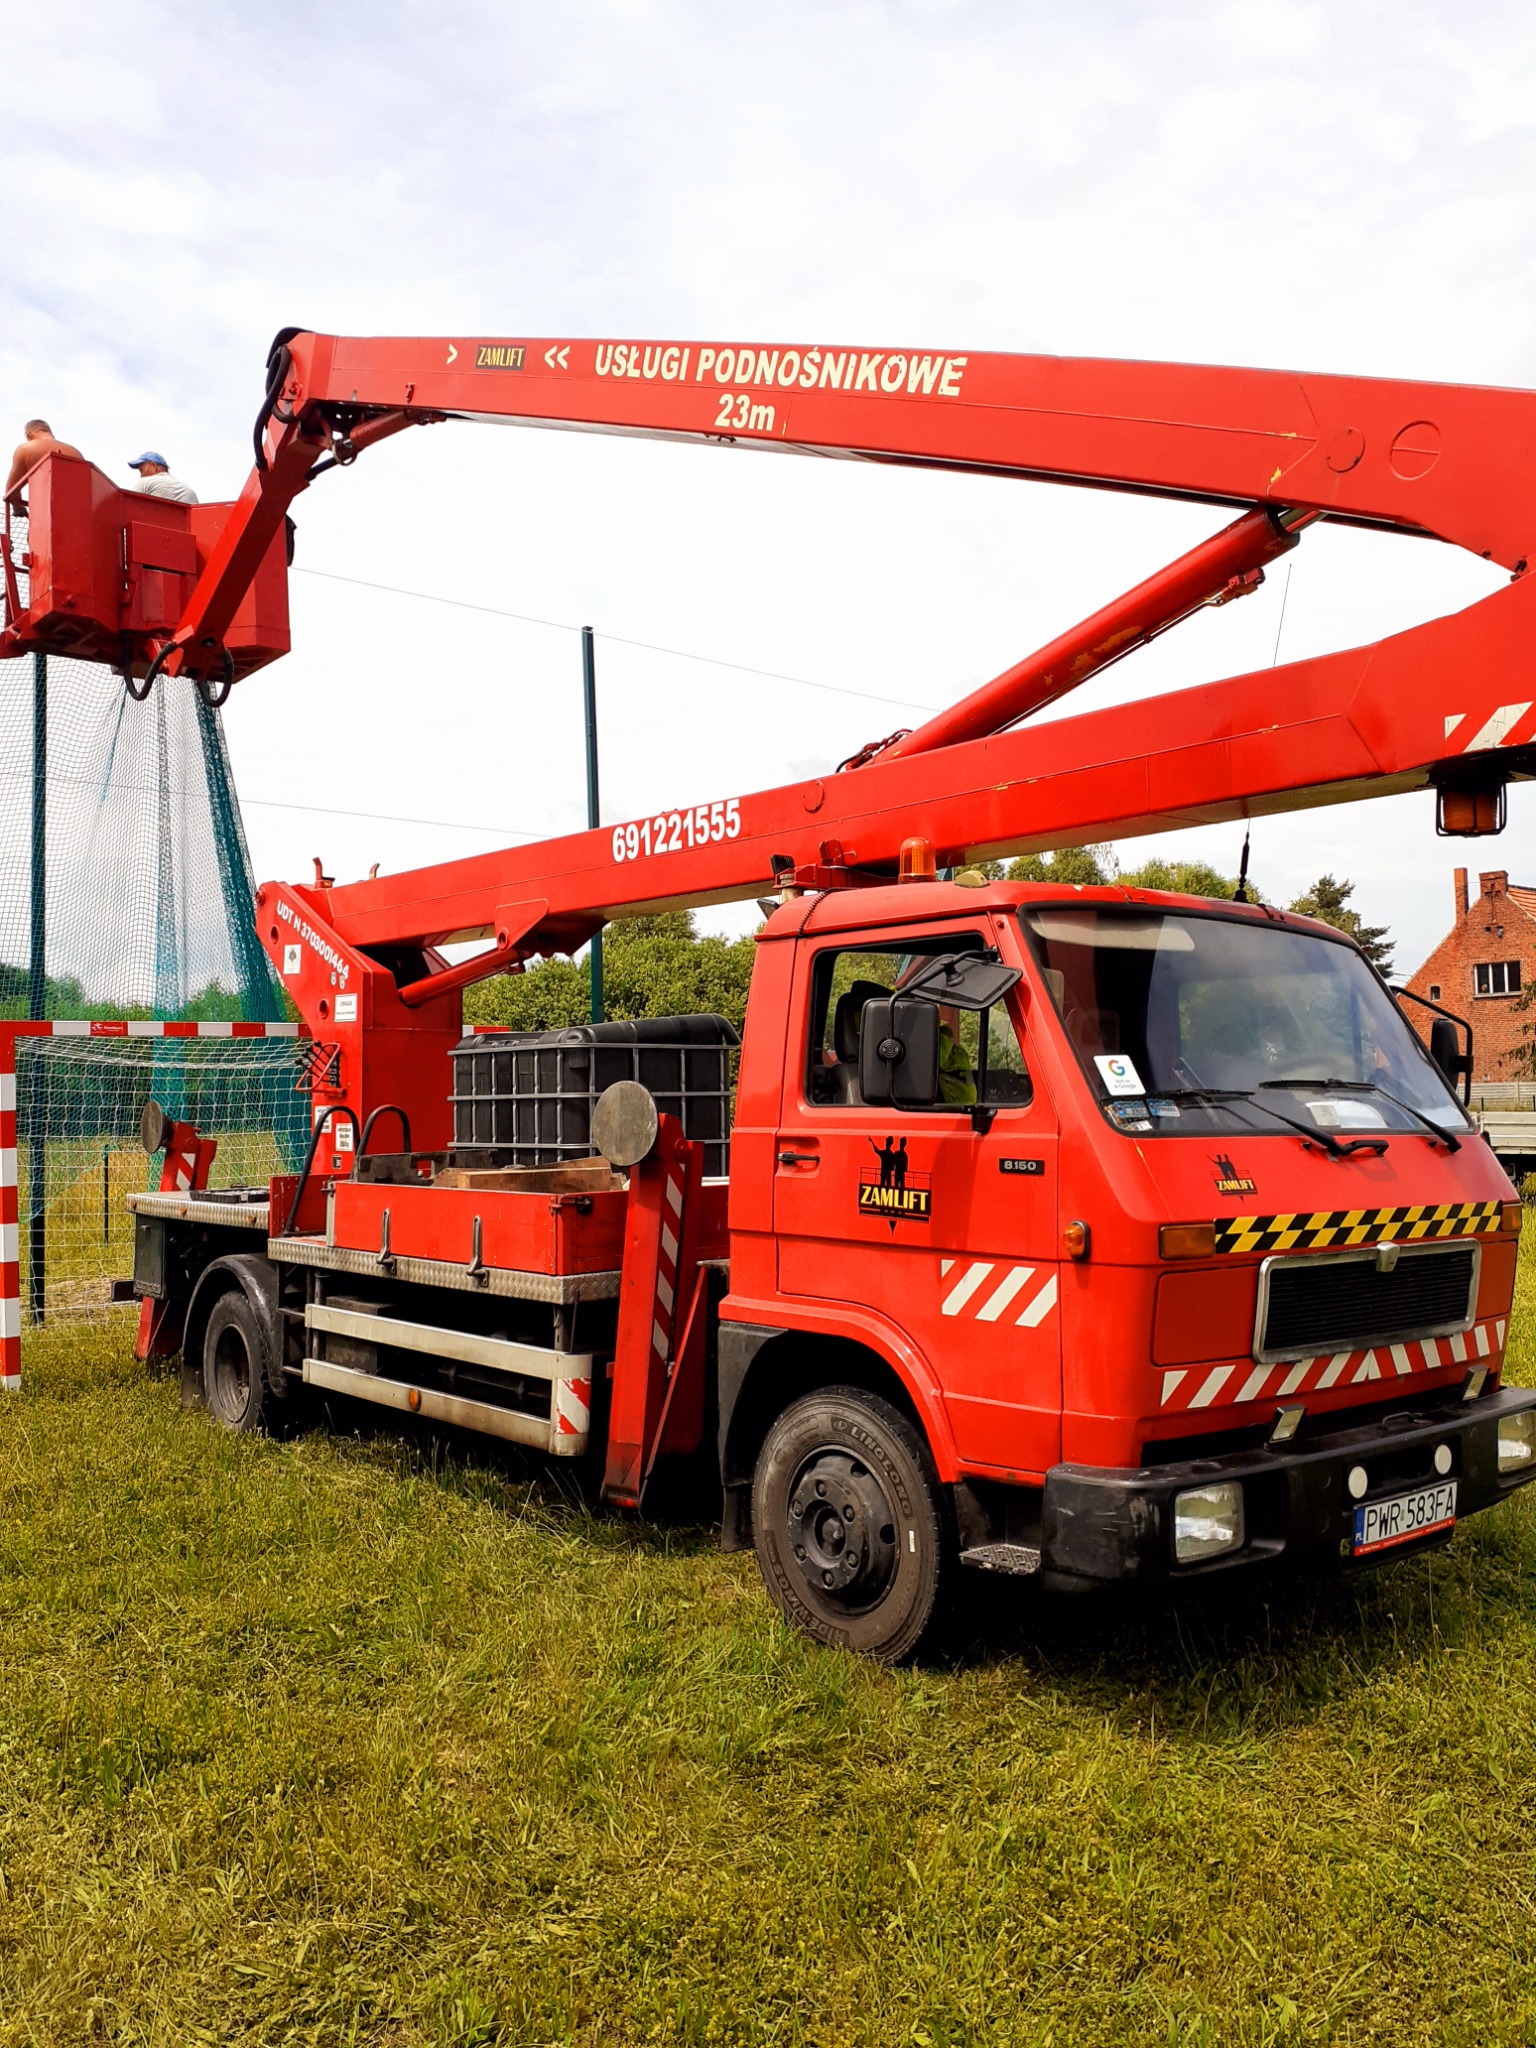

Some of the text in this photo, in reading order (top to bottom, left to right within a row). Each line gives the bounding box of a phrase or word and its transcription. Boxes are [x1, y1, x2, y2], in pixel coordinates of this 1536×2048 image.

[477, 347, 525, 367] ZAMLIFT
[595, 344, 968, 396] USŁUGI PODNOŚNIKOWE
[714, 394, 775, 431] 23m
[612, 799, 741, 862] 691221555
[277, 899, 294, 924] UDT
[301, 921, 349, 980] 3703001464
[860, 1185, 929, 1211] ZAMLIFT
[1216, 1179, 1255, 1191] ZAMLIFT
[1366, 1502, 1400, 1542] PWR
[1406, 1486, 1454, 1528] 583FA
